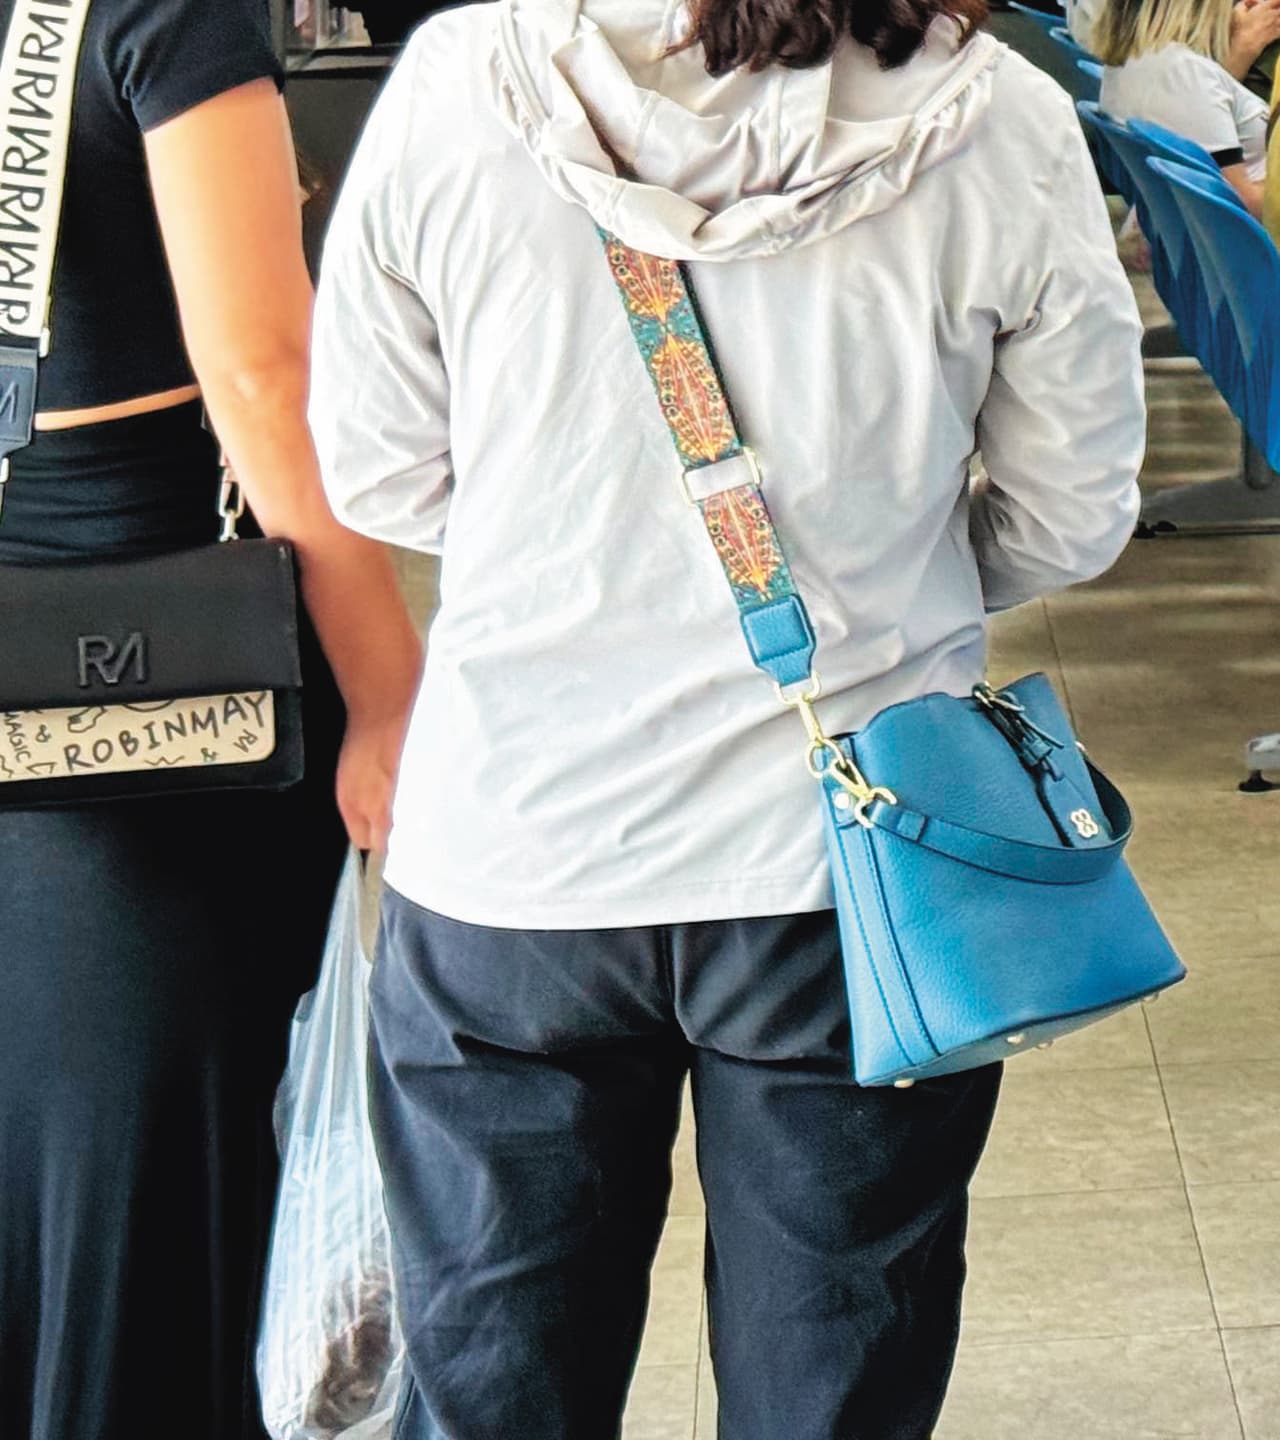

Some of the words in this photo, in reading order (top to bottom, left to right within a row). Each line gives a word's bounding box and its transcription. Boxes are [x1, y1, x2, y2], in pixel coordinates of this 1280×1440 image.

[18, 12, 69, 64] RM
[8, 68, 59, 120] RM
[1, 124, 53, 177] RM
[63, 691, 268, 772] ROBINMAY
